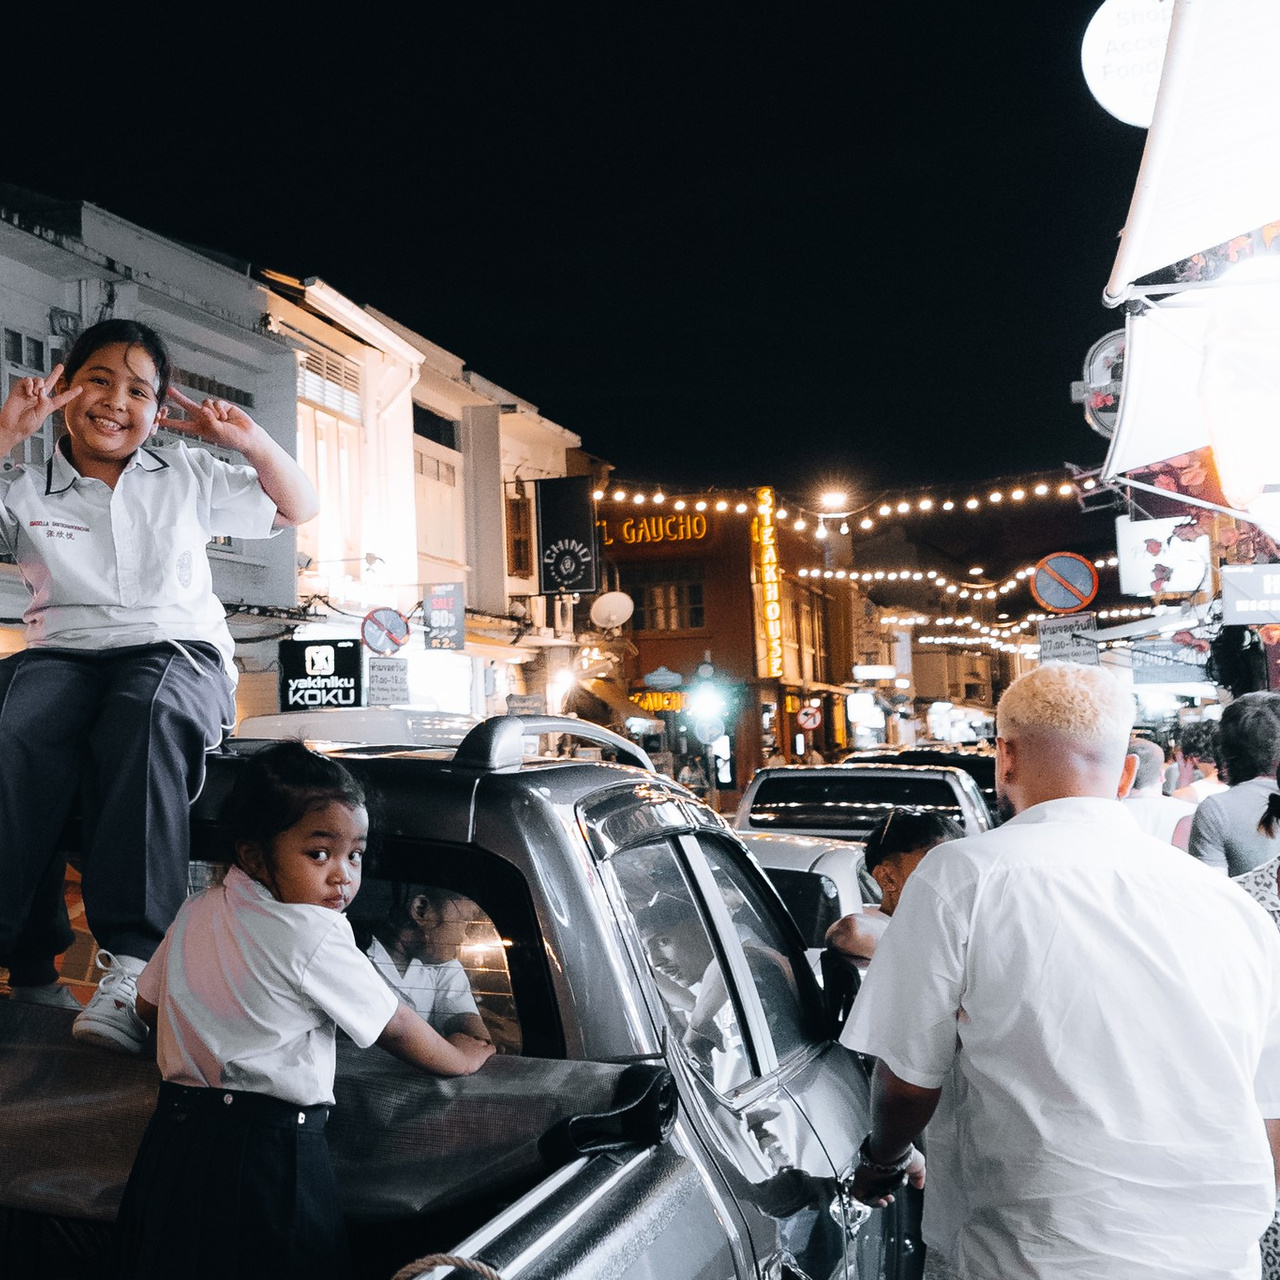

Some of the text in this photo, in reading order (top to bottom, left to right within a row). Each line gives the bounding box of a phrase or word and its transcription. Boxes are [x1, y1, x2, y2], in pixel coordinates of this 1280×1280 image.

[622, 514, 707, 545] GAUCHO
[544, 539, 592, 563] CHINO
[757, 486, 784, 678] STEAKHOUSE
[431, 597, 455, 610] SALE
[288, 676, 355, 690] yakiniku
[288, 689, 355, 705] KOKU
